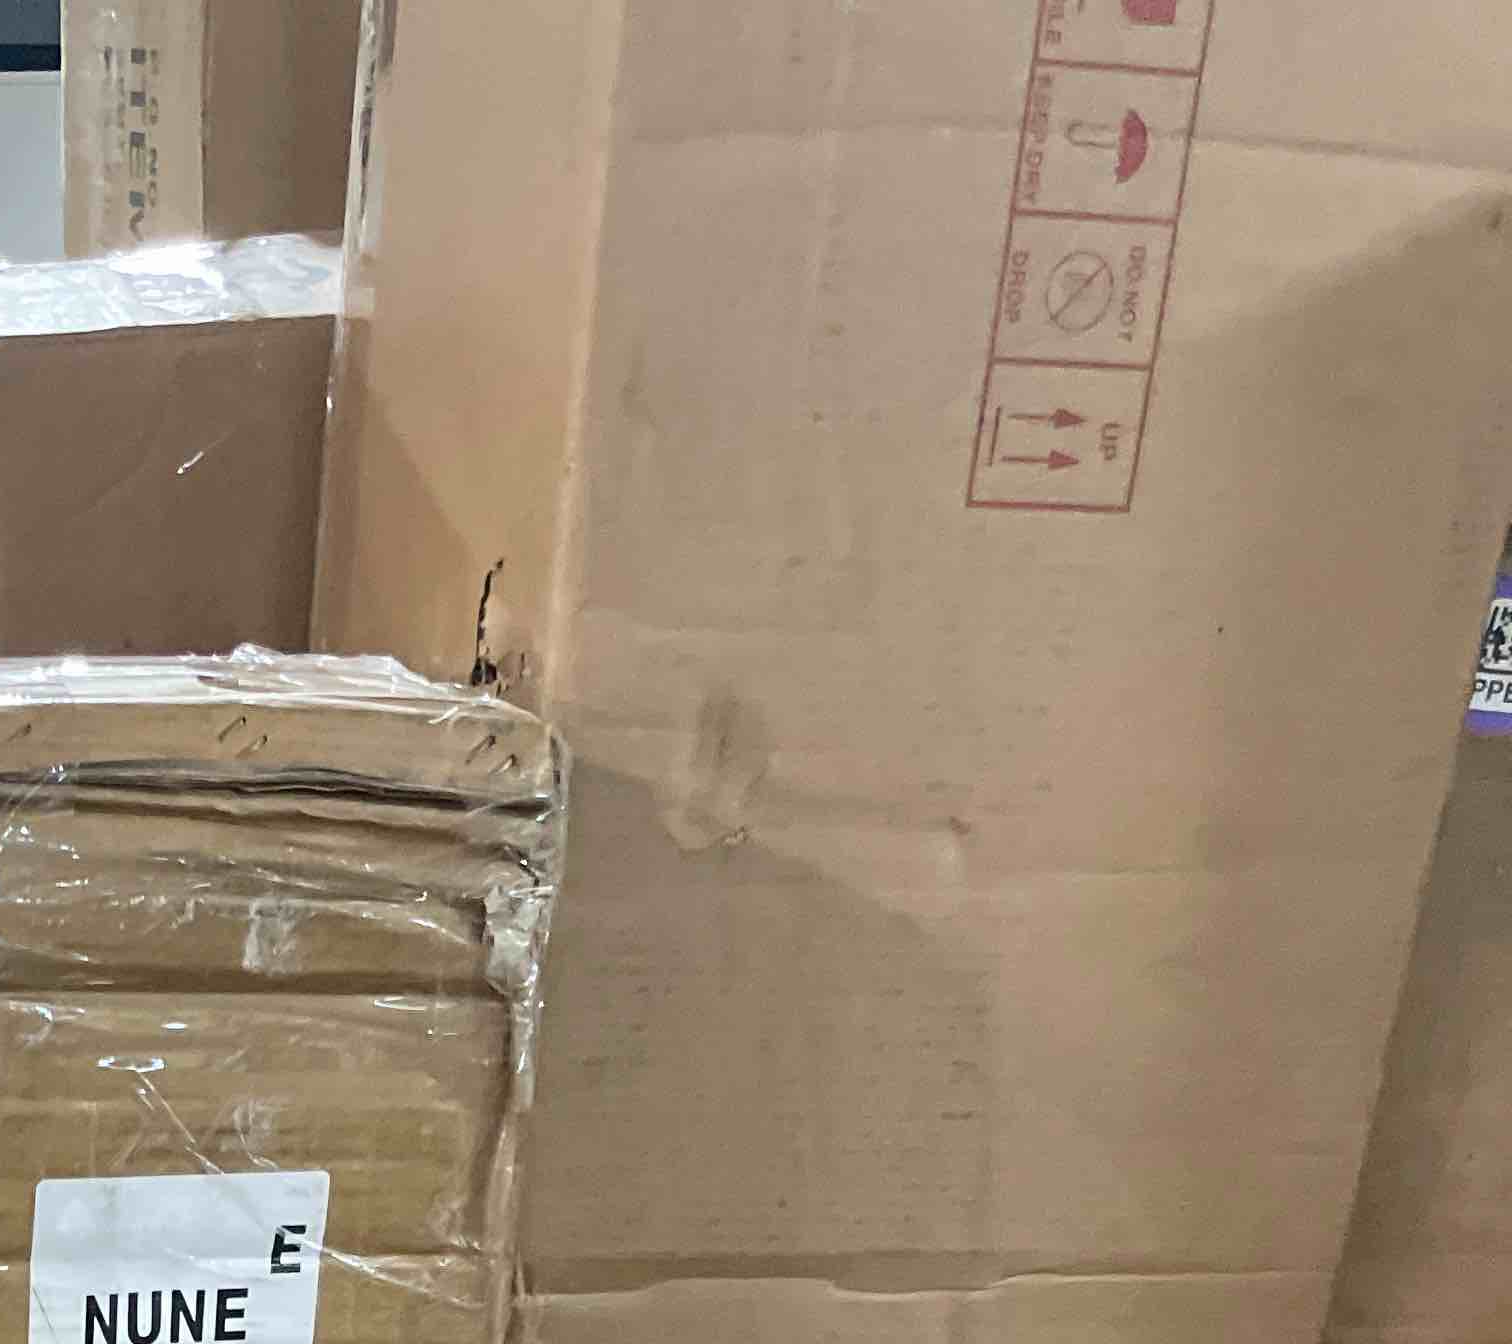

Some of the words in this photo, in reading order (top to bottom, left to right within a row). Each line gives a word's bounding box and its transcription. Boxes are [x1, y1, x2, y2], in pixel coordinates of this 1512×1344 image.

[1004, 250, 1030, 324] DROP
[1125, 246, 1148, 280] DO
[1117, 290, 1140, 343] NOT
[1099, 421, 1121, 461] UP
[270, 1224, 306, 1274] E
